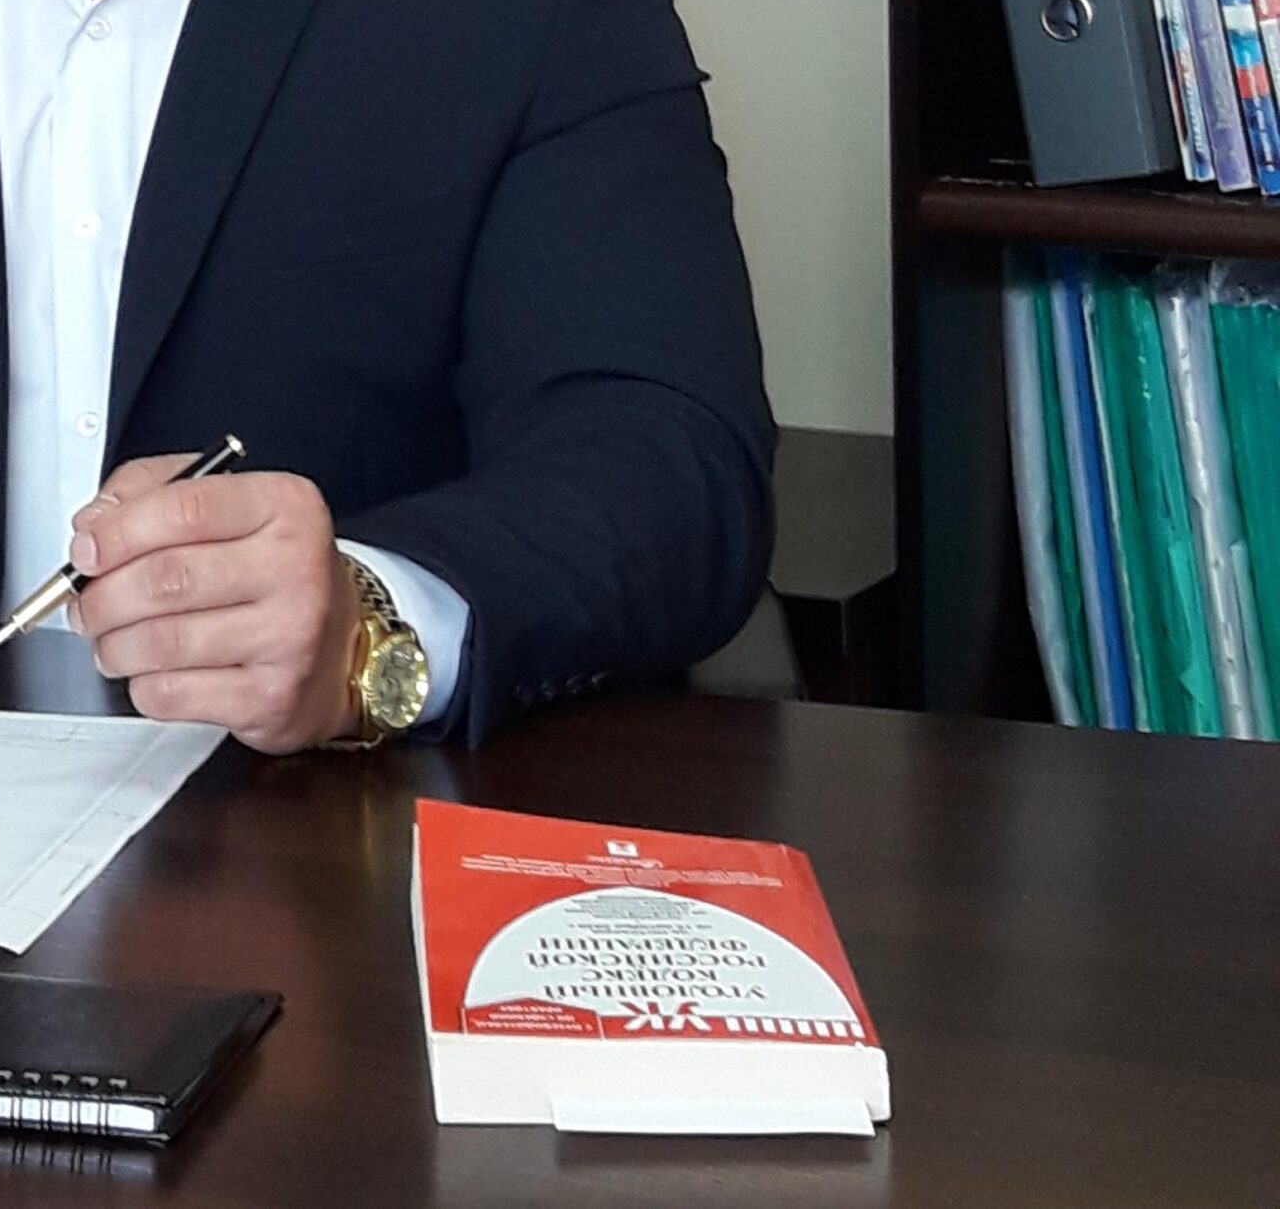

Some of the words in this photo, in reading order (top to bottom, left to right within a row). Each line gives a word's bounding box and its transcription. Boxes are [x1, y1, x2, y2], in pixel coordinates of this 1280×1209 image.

[539, 937, 748, 951] ФЕДЕРАЦИИ
[528, 953, 767, 968] РОССИЙСКОЙ
[581, 969, 717, 982] КОДЕКС
[546, 984, 767, 999] УГОЛОВНЫЙ
[619, 1001, 711, 1033] УК
